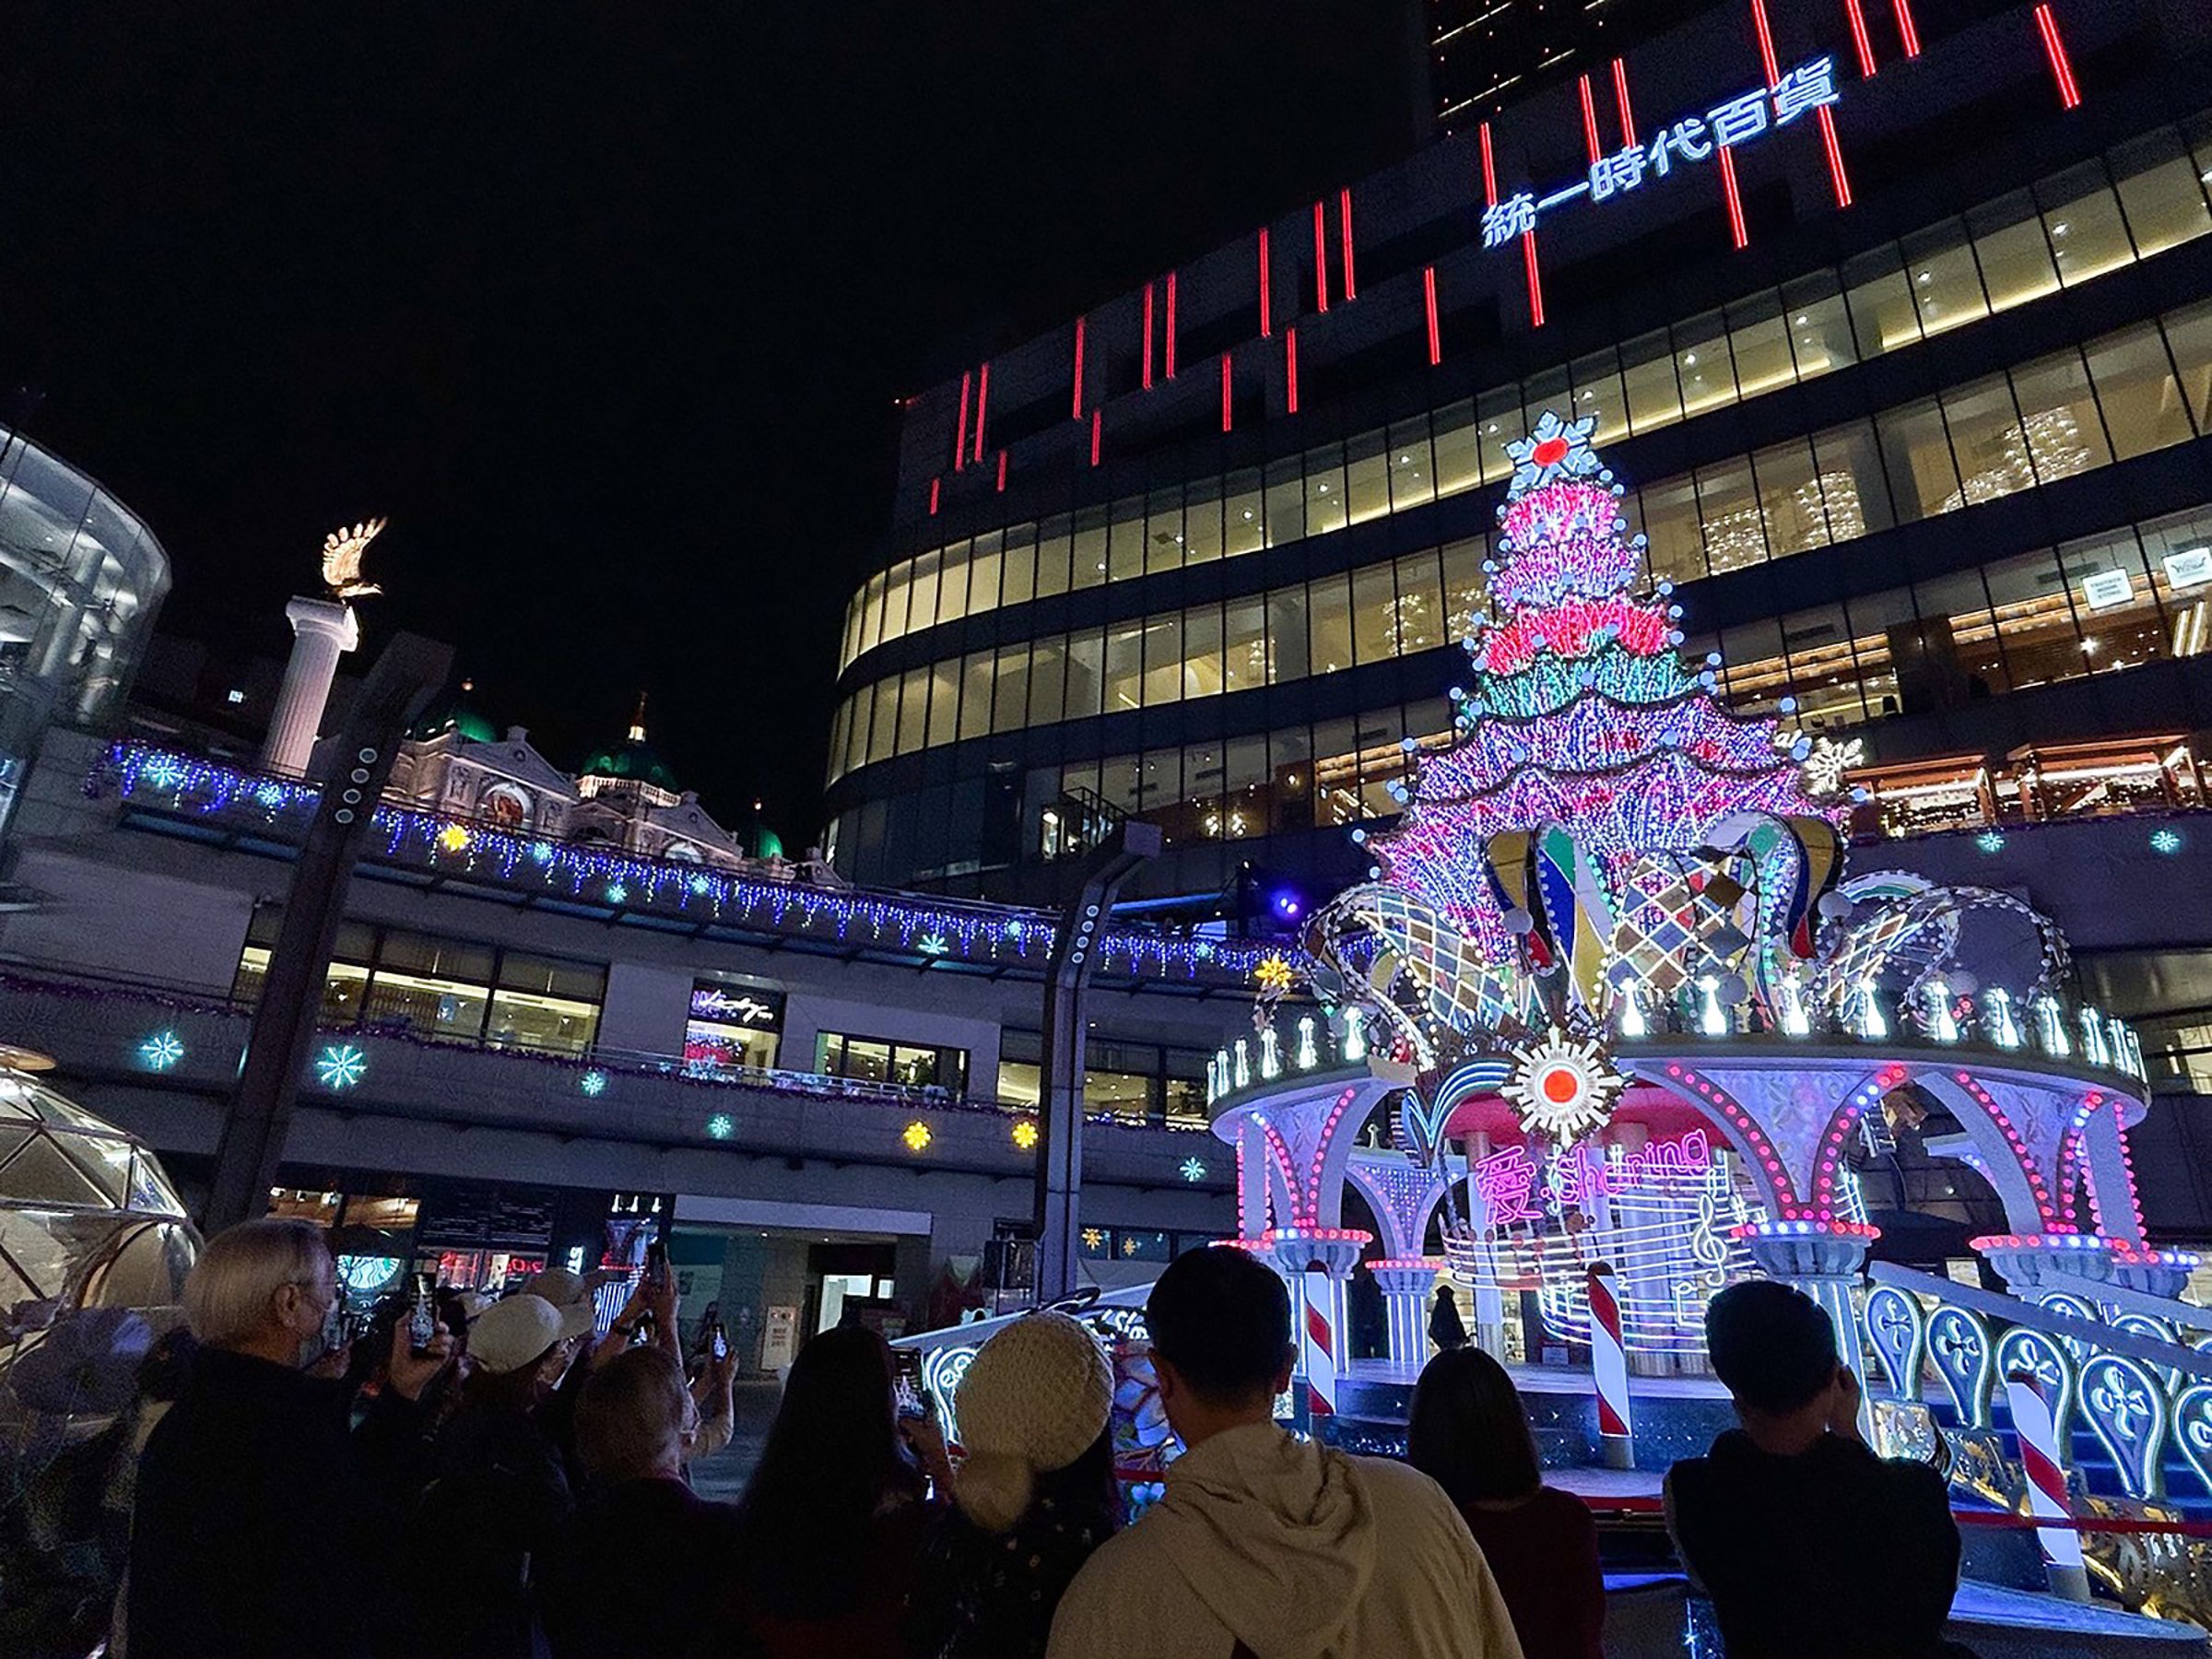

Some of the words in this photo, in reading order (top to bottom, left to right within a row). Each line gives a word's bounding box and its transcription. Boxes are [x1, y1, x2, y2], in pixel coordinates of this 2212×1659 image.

[1481, 56, 1840, 248] 統一時代百貨
[1476, 1145, 1544, 1225] 愛
